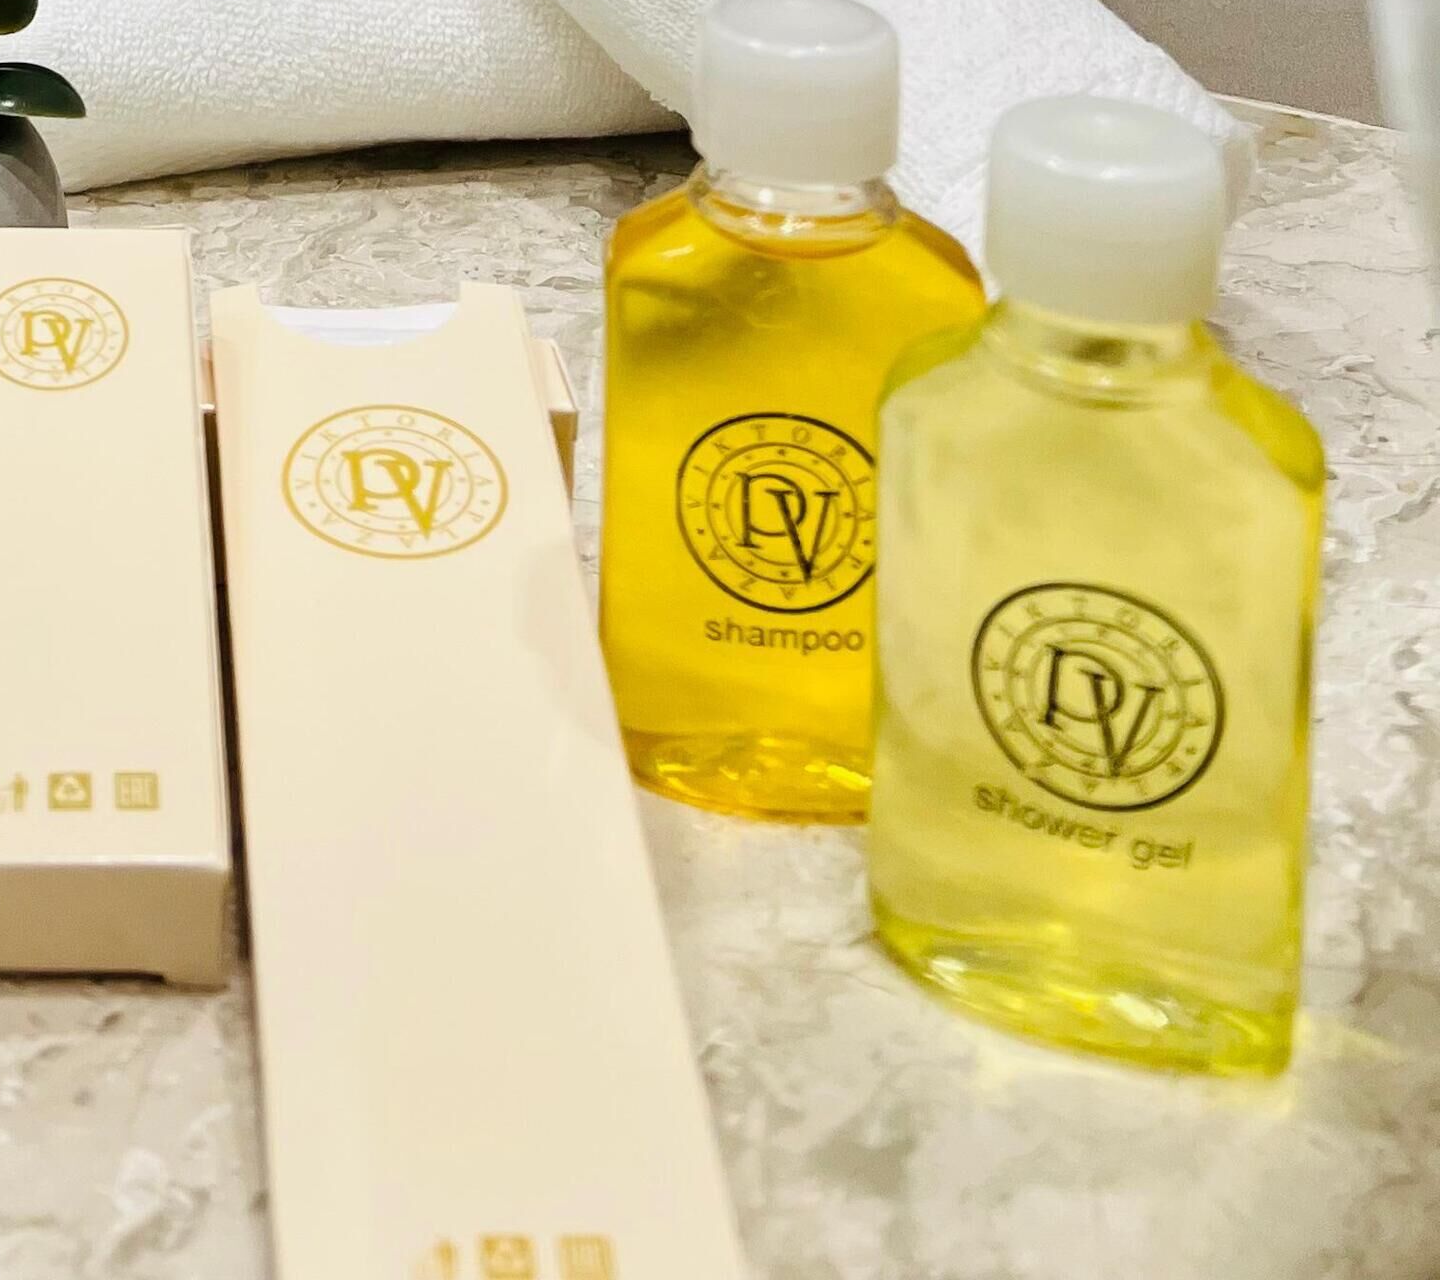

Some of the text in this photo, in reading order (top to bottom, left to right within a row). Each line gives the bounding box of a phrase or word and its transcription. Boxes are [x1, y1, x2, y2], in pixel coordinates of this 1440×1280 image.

[19, 309, 95, 375] PV
[295, 413, 493, 490] VIKTORIA
[340, 447, 454, 541] PV
[735, 472, 840, 584] PV
[704, 617, 866, 655] shampoo
[1036, 642, 1166, 778] PV
[971, 782, 1195, 871] shower gel
